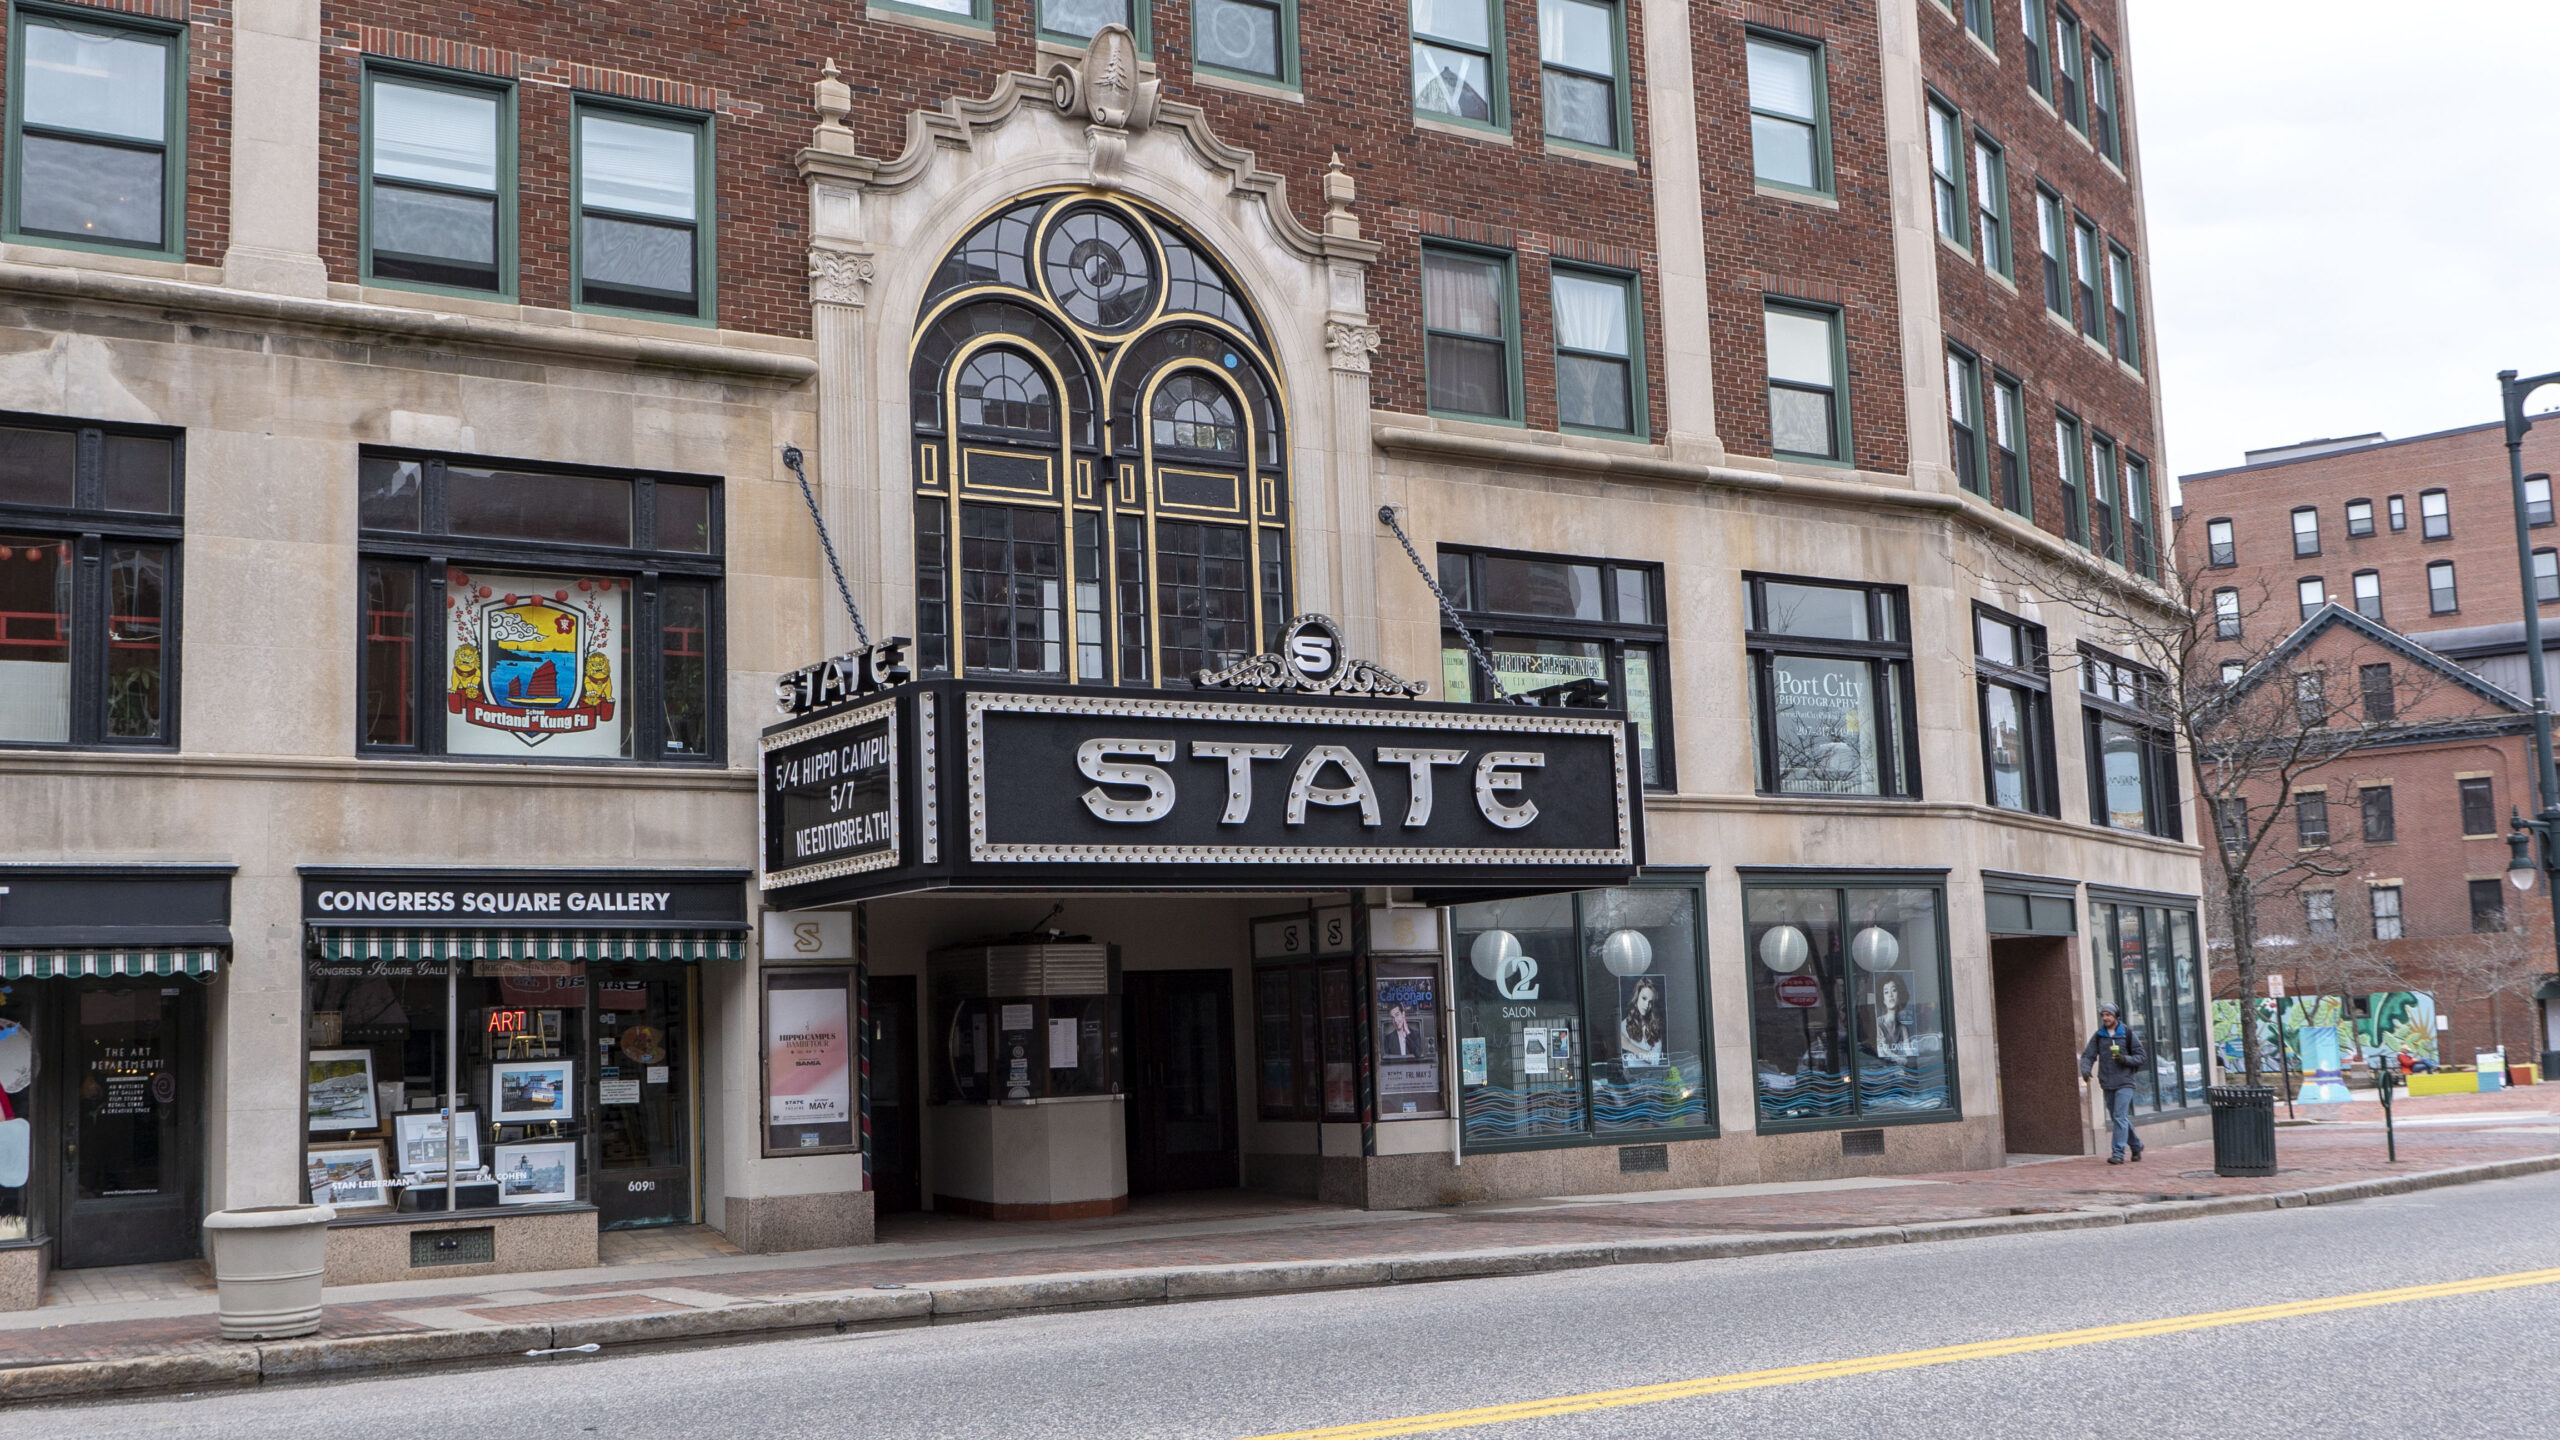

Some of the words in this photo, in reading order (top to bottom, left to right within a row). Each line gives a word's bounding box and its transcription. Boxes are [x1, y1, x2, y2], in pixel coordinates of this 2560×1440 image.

[1292, 636, 1332, 672] S
[1492, 653, 1532, 672] TARDIFF
[1541, 655, 1600, 677] ELECTRONICS
[776, 637, 912, 714] STATE
[1777, 670, 1820, 696] Port
[1823, 673, 1863, 704] City
[1779, 695, 1855, 708] PHOTOGRAPHY
[475, 707, 530, 728] Portland
[540, 715, 572, 729] Kung
[574, 714, 589, 727] Fu
[776, 760, 798, 792] 5/4
[803, 750, 837, 785] HIPPO
[842, 735, 890, 774] CAMPU
[1075, 738, 1546, 829] STATE
[830, 781, 855, 813] 5/7
[796, 810, 890, 857] NEEDTOBREATH
[318, 891, 456, 911] CONGRESS
[462, 892, 561, 913] SQUARE
[567, 892, 671, 911] GALLERY
[794, 922, 823, 952] S
[488, 1011, 526, 1032] ART
[1502, 1006, 1536, 1017] SALON
[105, 1048, 125, 1057] THE
[130, 1048, 151, 1056] ART
[809, 1102, 828, 1110] MAY
[828, 1101, 834, 1109] 4
[332, 1180, 357, 1190] STAN
[358, 1178, 411, 1188] LEIBERMAN
[497, 1172, 527, 1181] COHEN
